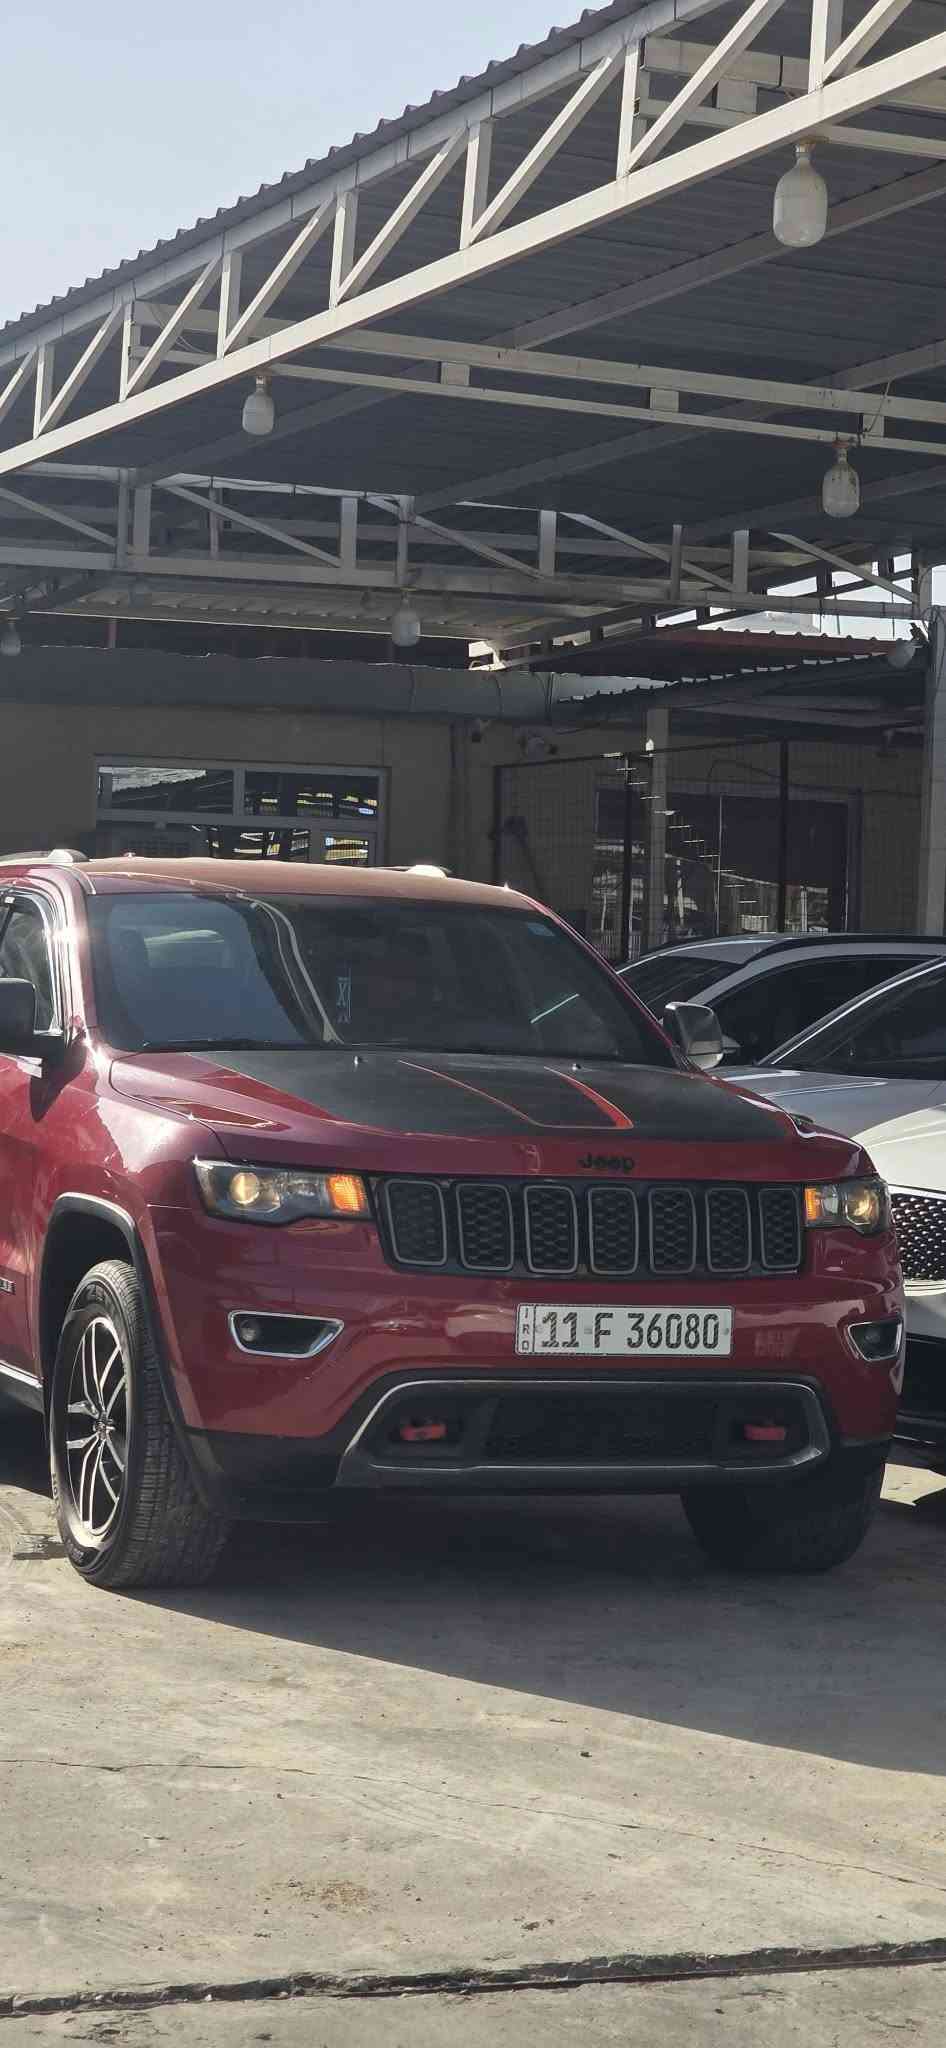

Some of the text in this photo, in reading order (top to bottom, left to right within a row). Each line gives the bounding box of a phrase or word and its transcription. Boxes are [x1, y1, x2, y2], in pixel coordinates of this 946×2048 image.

[578, 1152, 635, 1173] Jeep
[541, 1311, 719, 1349] 11 F 36080
